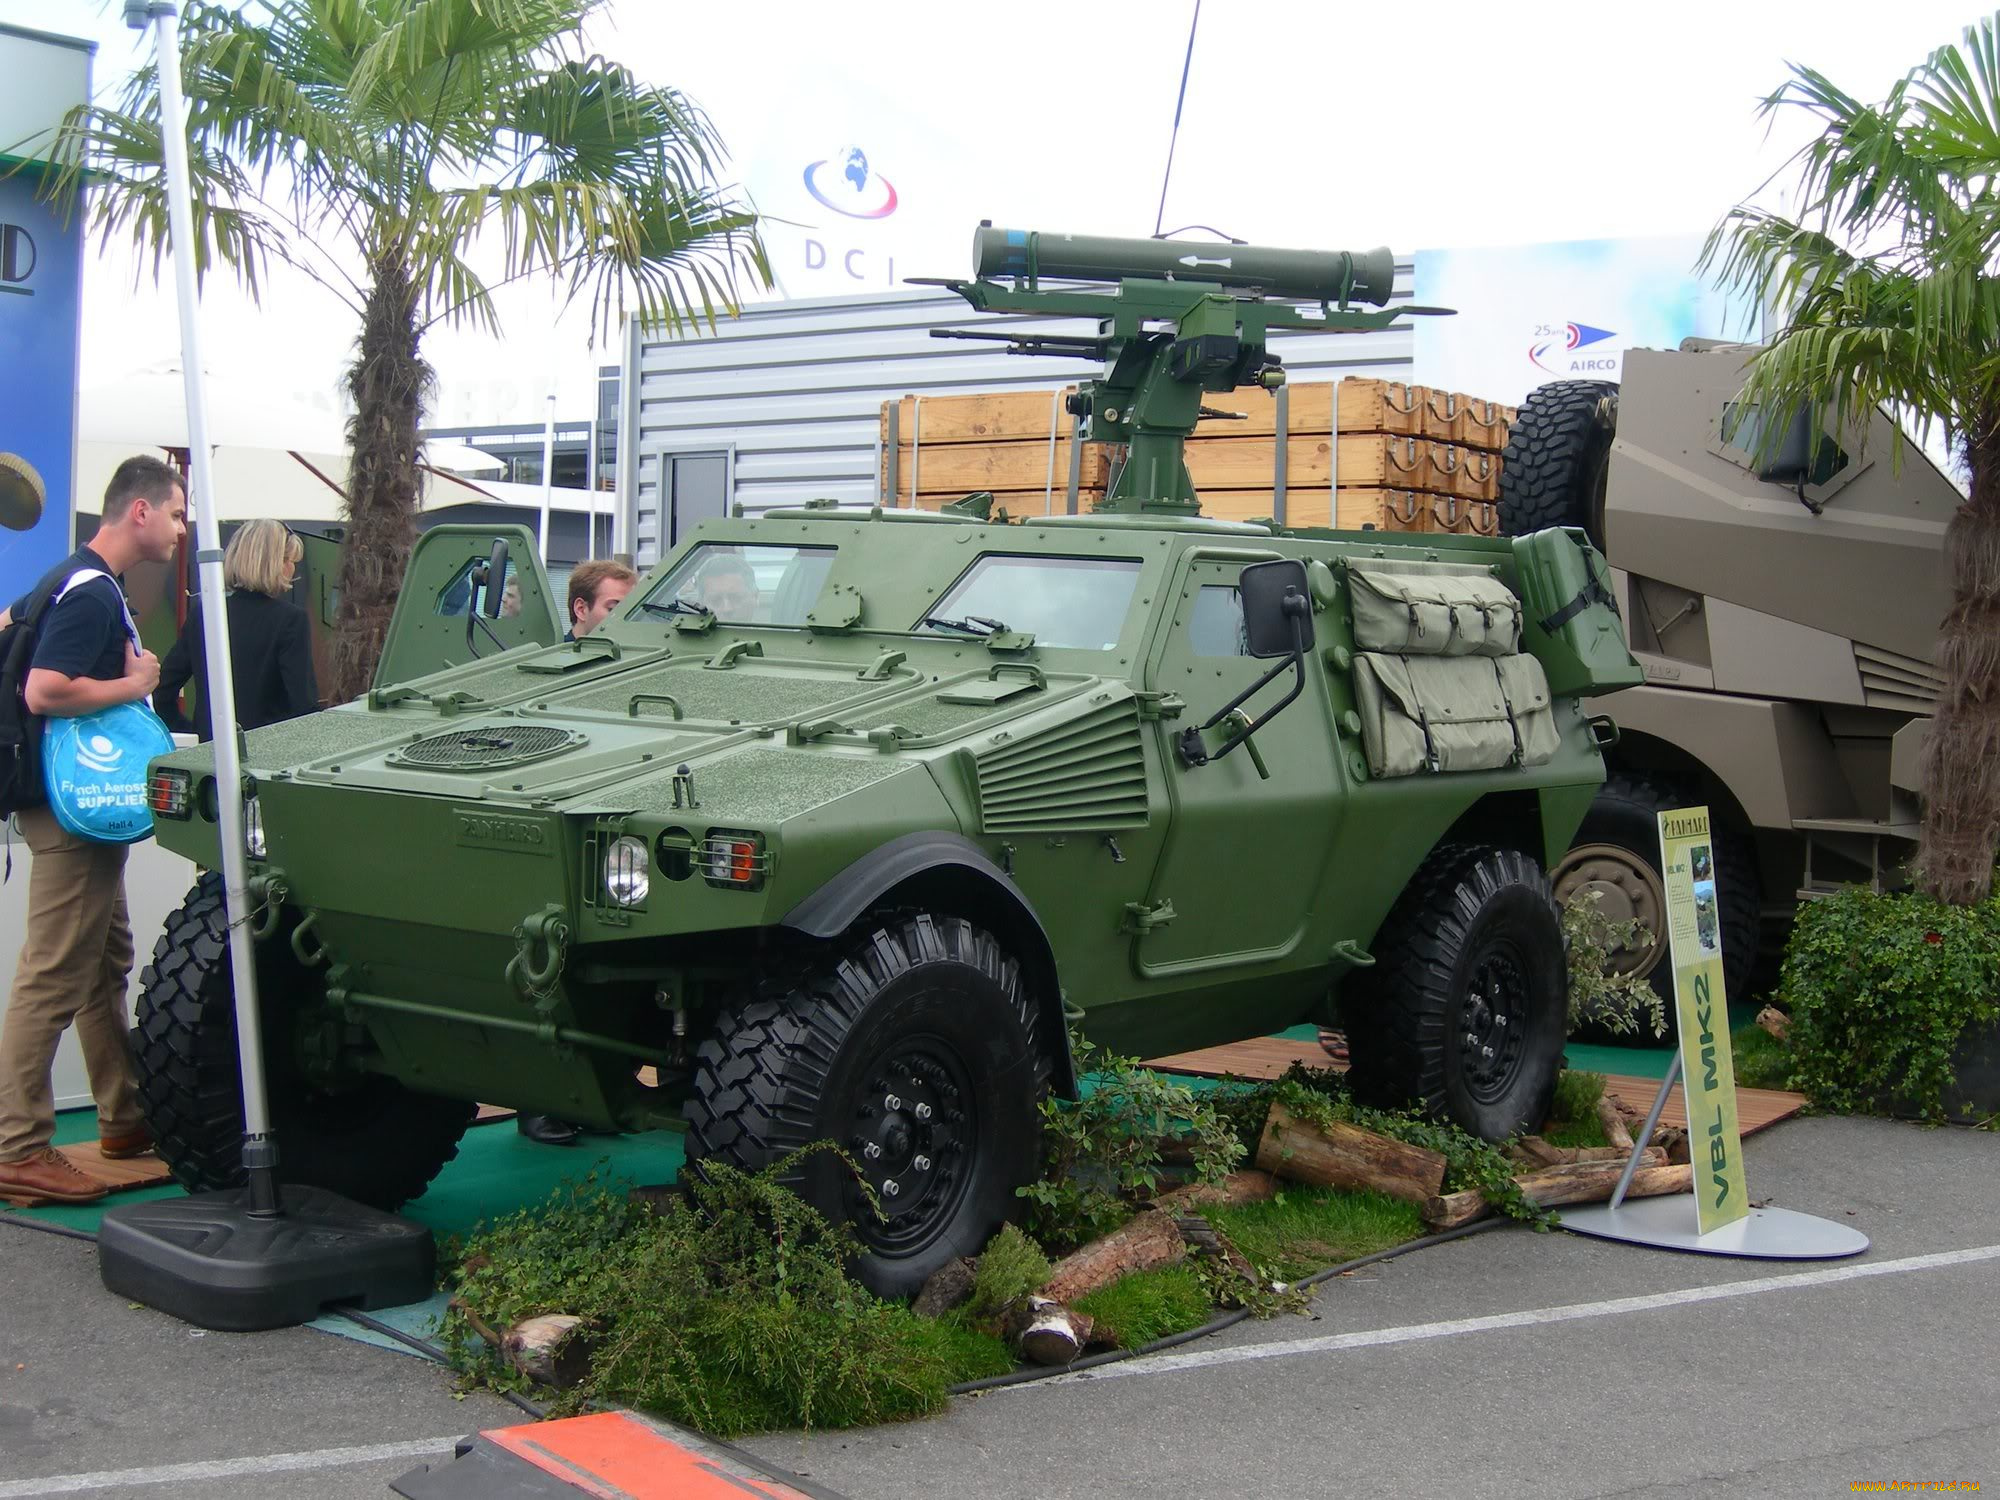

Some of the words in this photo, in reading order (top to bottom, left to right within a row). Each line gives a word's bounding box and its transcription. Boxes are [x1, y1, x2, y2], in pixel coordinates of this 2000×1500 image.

[805, 239, 894, 286] DCI
[1570, 359, 1616, 371] AIRCO
[108, 821, 126, 830] Hall
[126, 821, 134, 829] 4
[1695, 972, 1718, 1091] MK2
[1709, 1104, 1729, 1209] VBL
